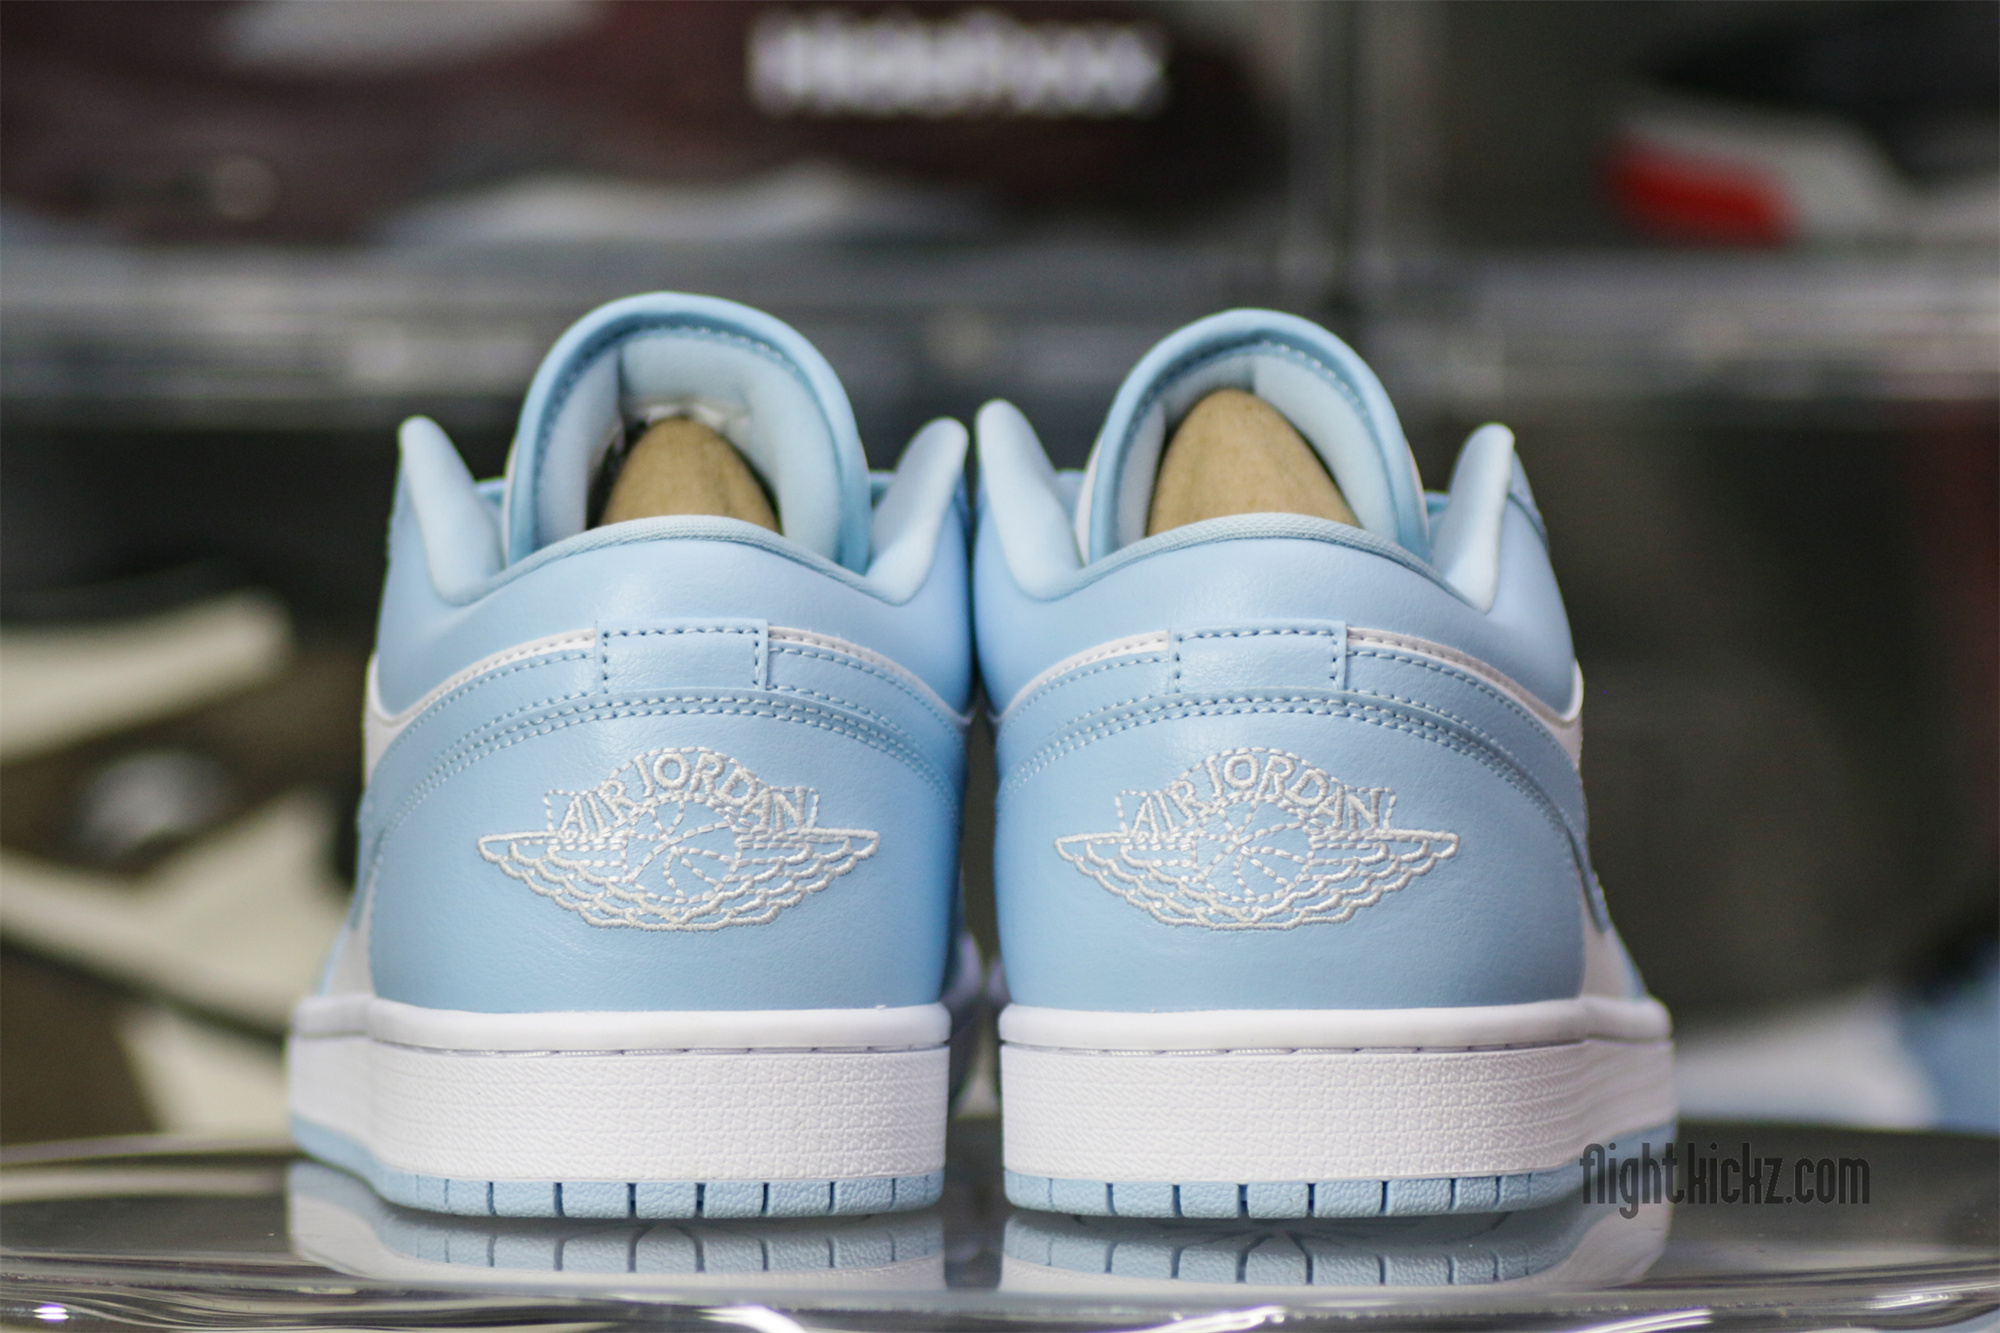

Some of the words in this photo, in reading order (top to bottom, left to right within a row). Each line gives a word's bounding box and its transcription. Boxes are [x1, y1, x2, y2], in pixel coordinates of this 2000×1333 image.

[560, 778, 637, 838] AIR
[634, 752, 808, 830] JORDAN
[1129, 779, 1203, 839] AIR
[1204, 753, 1381, 831] JORDAN
